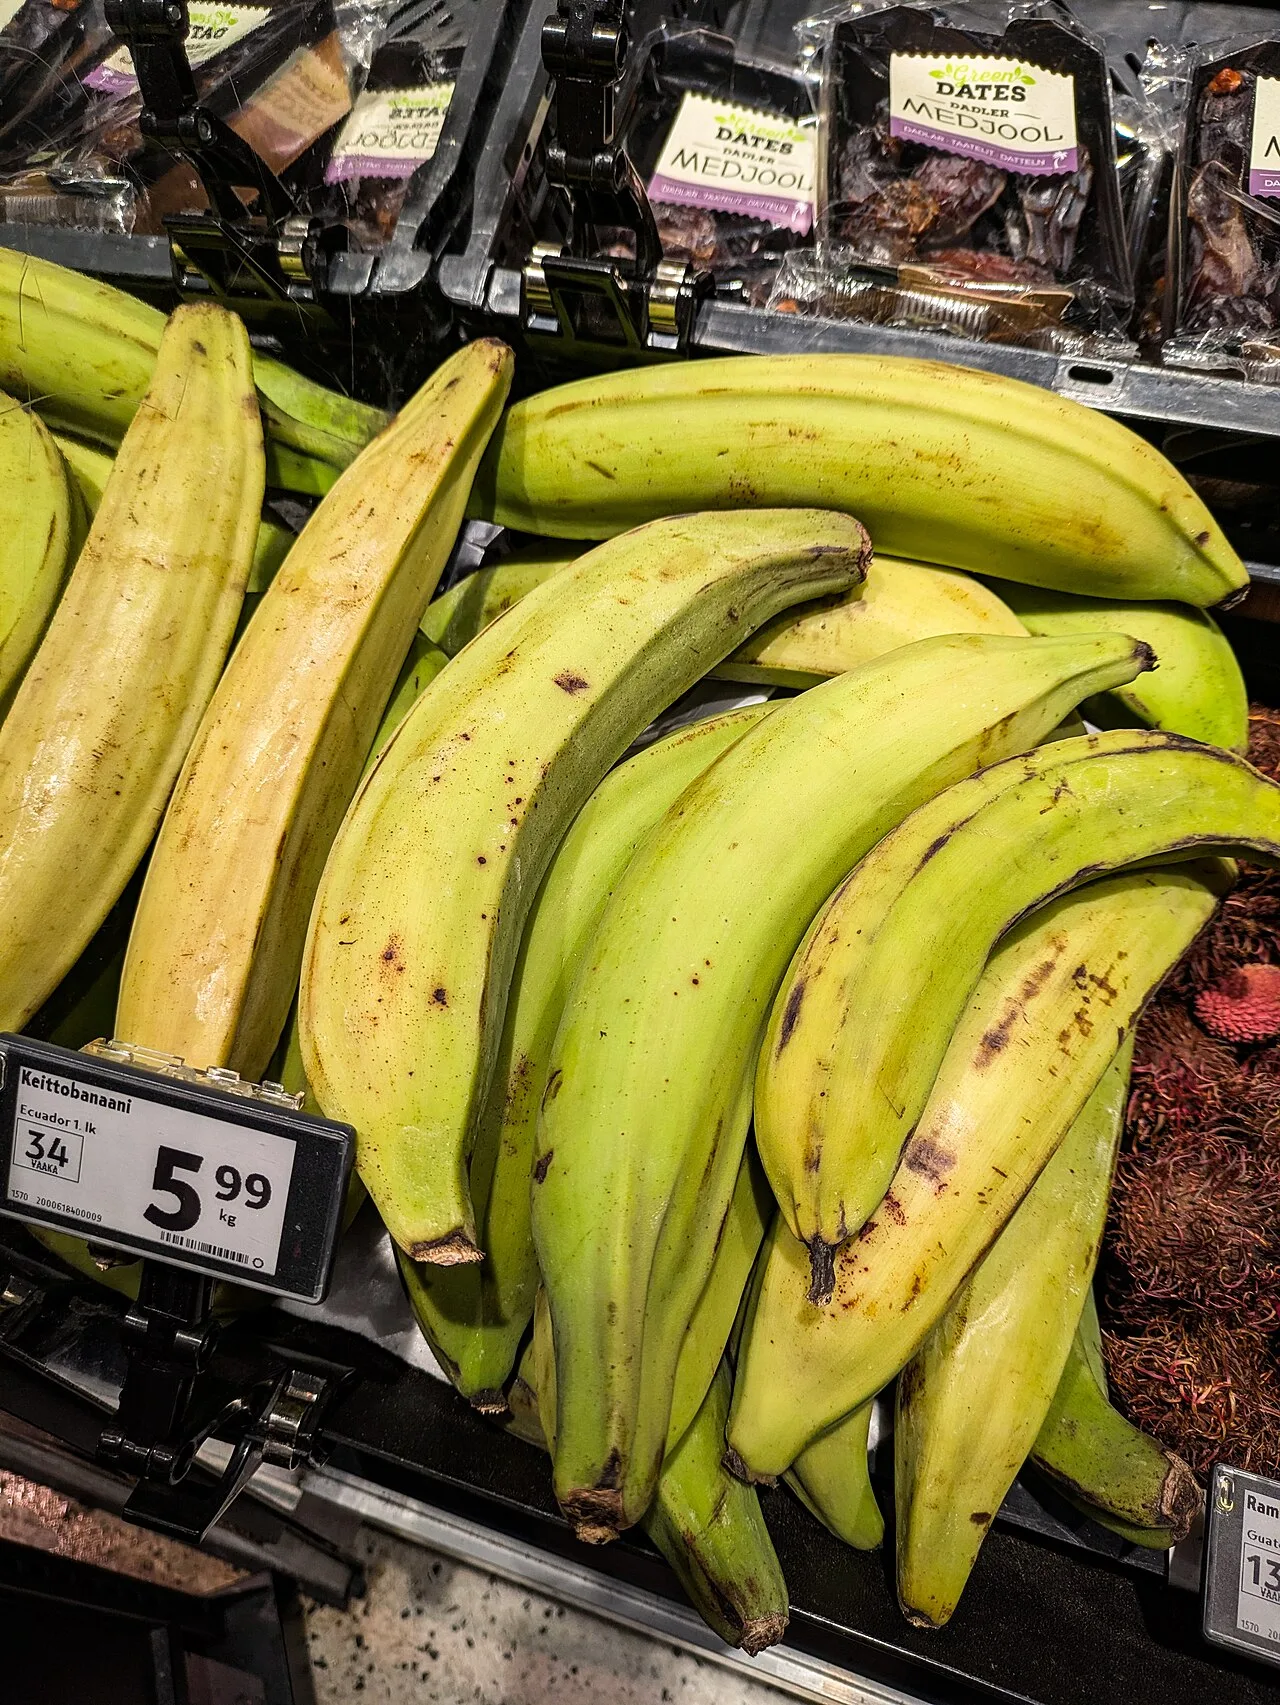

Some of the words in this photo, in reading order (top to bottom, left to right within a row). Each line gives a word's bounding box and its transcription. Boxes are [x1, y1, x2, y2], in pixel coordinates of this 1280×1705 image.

[953, 64, 1017, 87] Green
[936, 82, 1026, 102] DATES
[902, 98, 1063, 142] MEDJOOL
[949, 102, 1010, 118] DADLER
[715, 126, 793, 155] DATES
[723, 148, 775, 165] DADLER
[1000, 154, 1046, 167] DATTELN
[670, 148, 813, 192] MEDJOOL
[21, 1069, 132, 1114] Keittobanaani
[20, 1104, 71, 1127] Ecuador
[25, 1129, 69, 1167] 34
[31, 1159, 59, 1175] VAAKA
[143, 1145, 204, 1231] 5
[215, 1165, 272, 1209] 99
[11, 1189, 29, 1201] 1570
[36, 1196, 102, 1222] 2000618400009
[219, 1208, 237, 1227] kg
[1247, 1529, 1280, 1549] Guat
[1241, 1619, 1259, 1633] 1570
